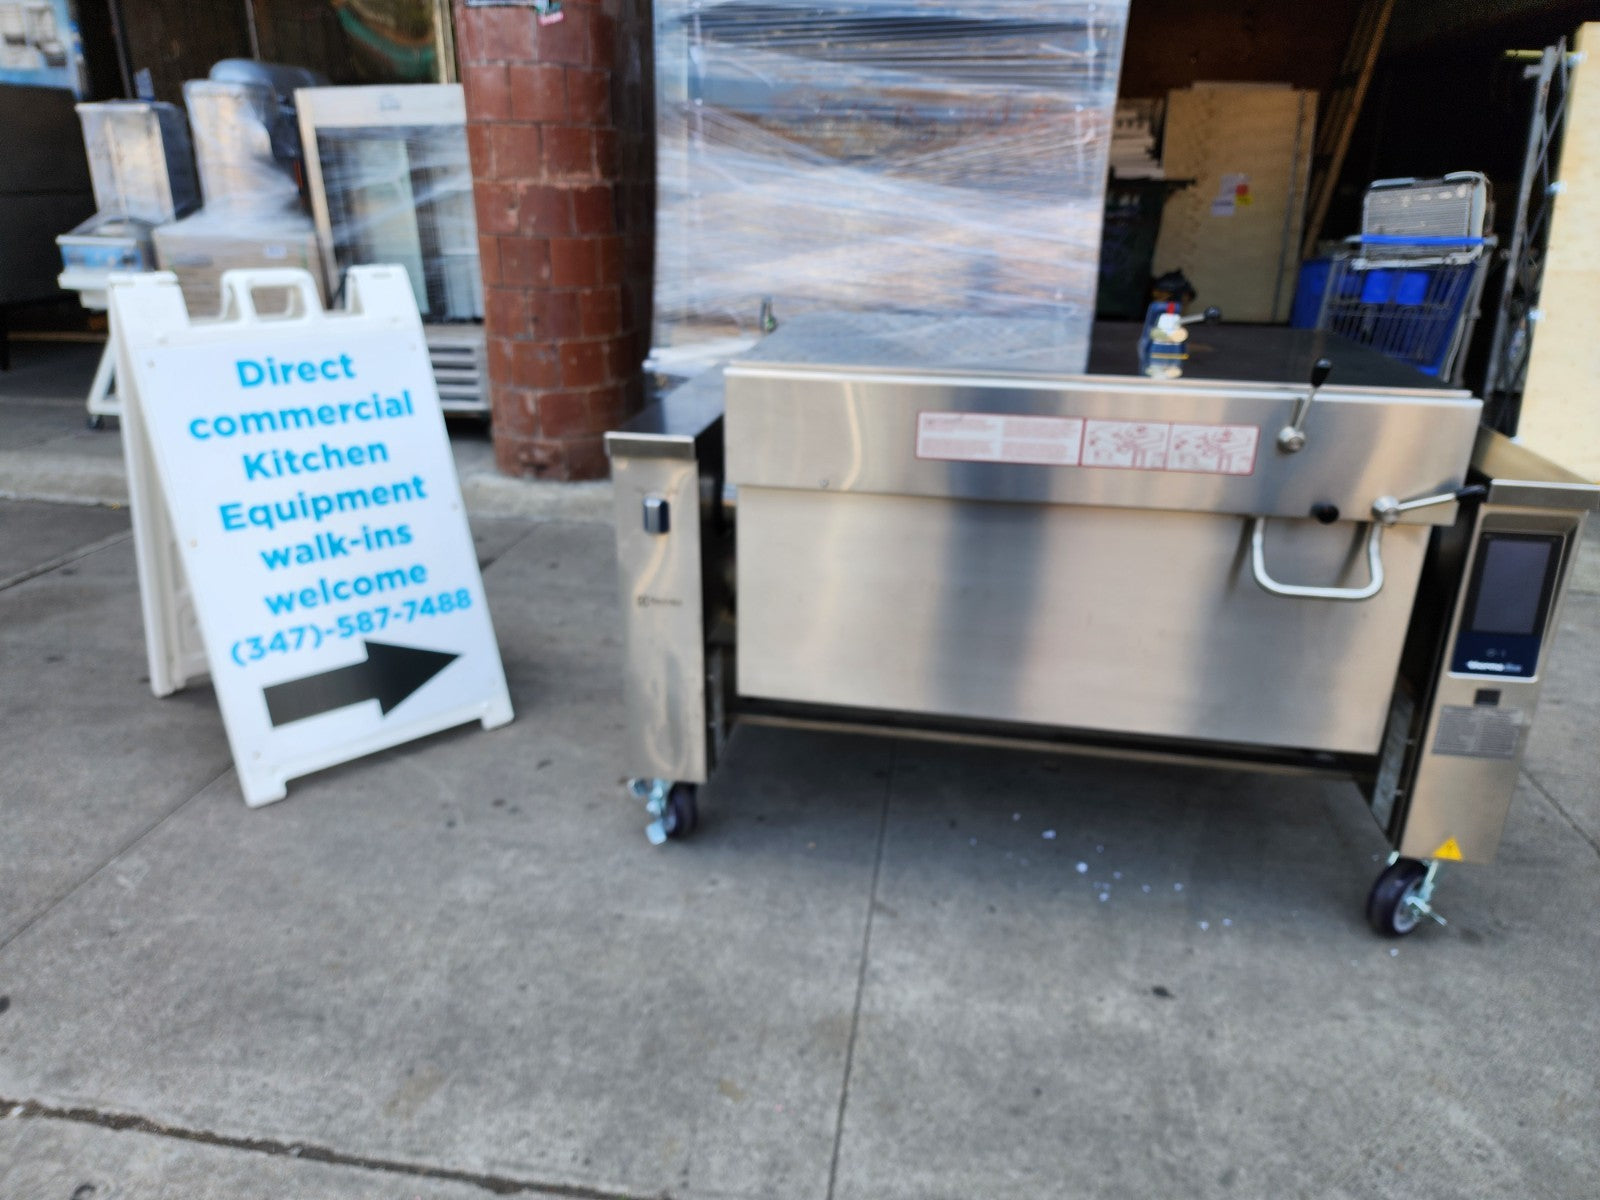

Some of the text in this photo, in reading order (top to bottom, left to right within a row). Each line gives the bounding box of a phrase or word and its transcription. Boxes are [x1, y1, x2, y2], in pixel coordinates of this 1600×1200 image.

[235, 353, 356, 389] Direct
[188, 389, 415, 441] commercial
[242, 441, 390, 481] Kitchen
[218, 474, 428, 532] Equipment
[259, 522, 414, 571] walk-ins
[263, 563, 428, 616] welcome
[230, 587, 474, 667] (347)-587-7488
